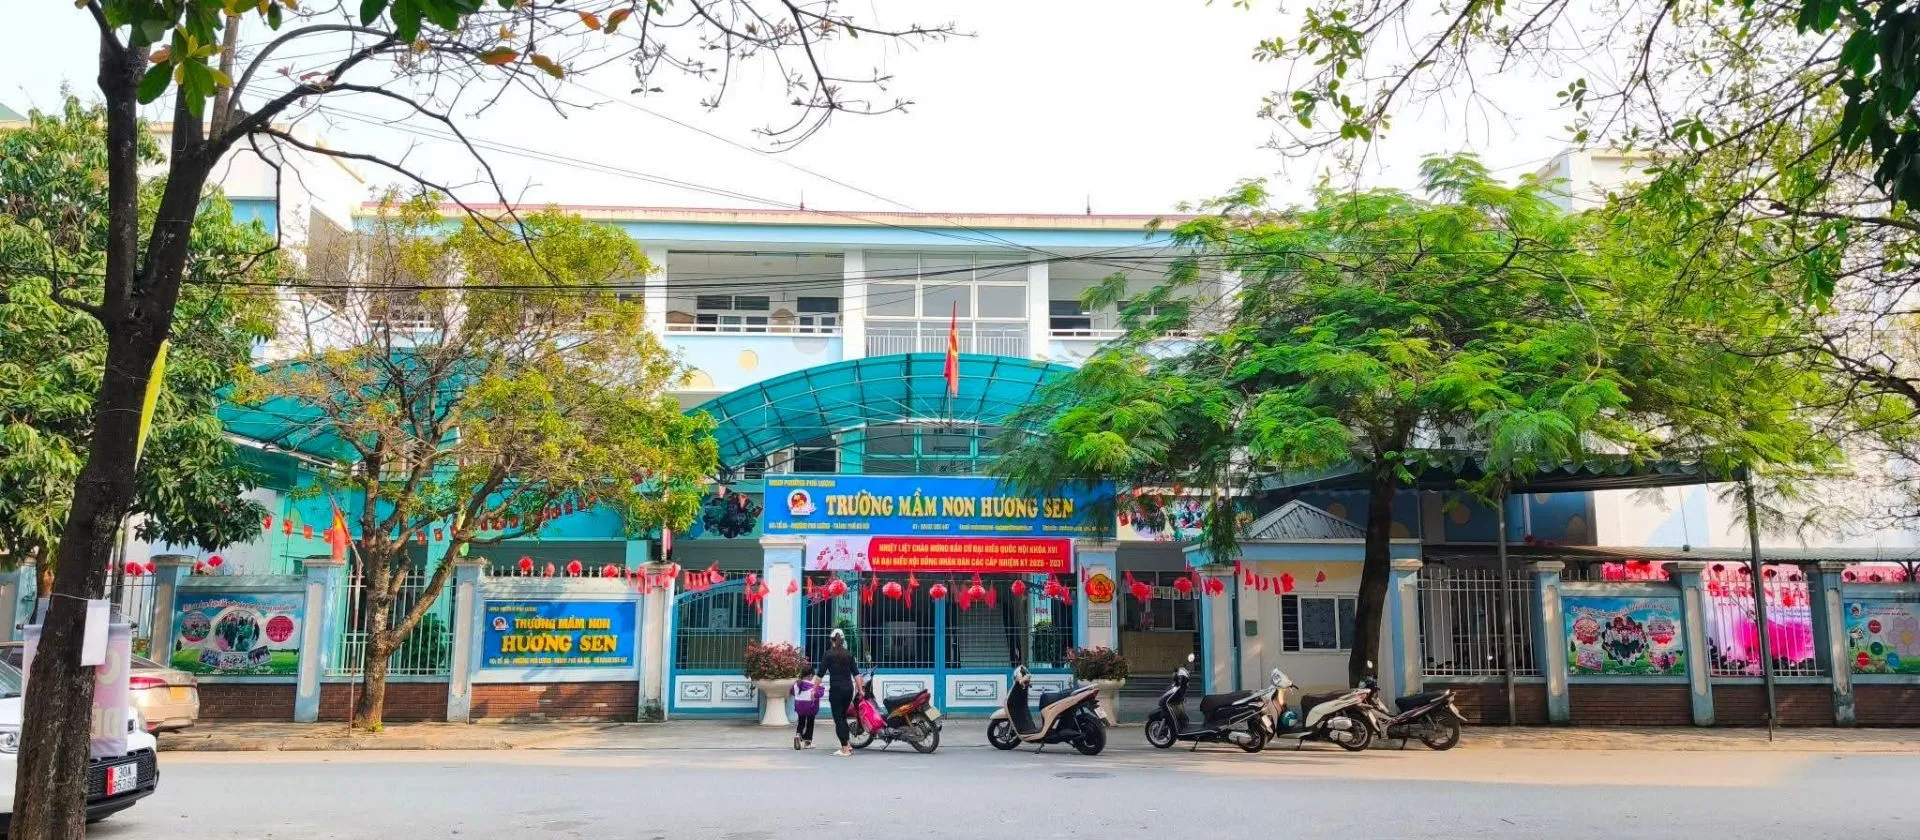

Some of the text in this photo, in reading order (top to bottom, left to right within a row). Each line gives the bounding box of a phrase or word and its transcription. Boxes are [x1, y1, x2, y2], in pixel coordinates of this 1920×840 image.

[826, 487, 1074, 518] TRƯỜNG MẦM NON HƯƠNG SEN
[879, 543, 897, 554] NHIỆT
[898, 543, 911, 554] LIỆT
[912, 543, 929, 553] CHÀO
[1000, 543, 1017, 555] QUỐC
[1018, 544, 1029, 555] HỘI
[1048, 545, 1058, 554] XVI
[872, 556, 880, 566] VÀ
[971, 556, 984, 567] CÁC
[985, 556, 998, 567] CẤP
[999, 556, 1019, 568] NHIỆM
[514, 615, 611, 630] TRƯỜNG MẦM NON
[501, 632, 618, 653] HƯƠNG SEN
[118, 766, 132, 778] 30A
